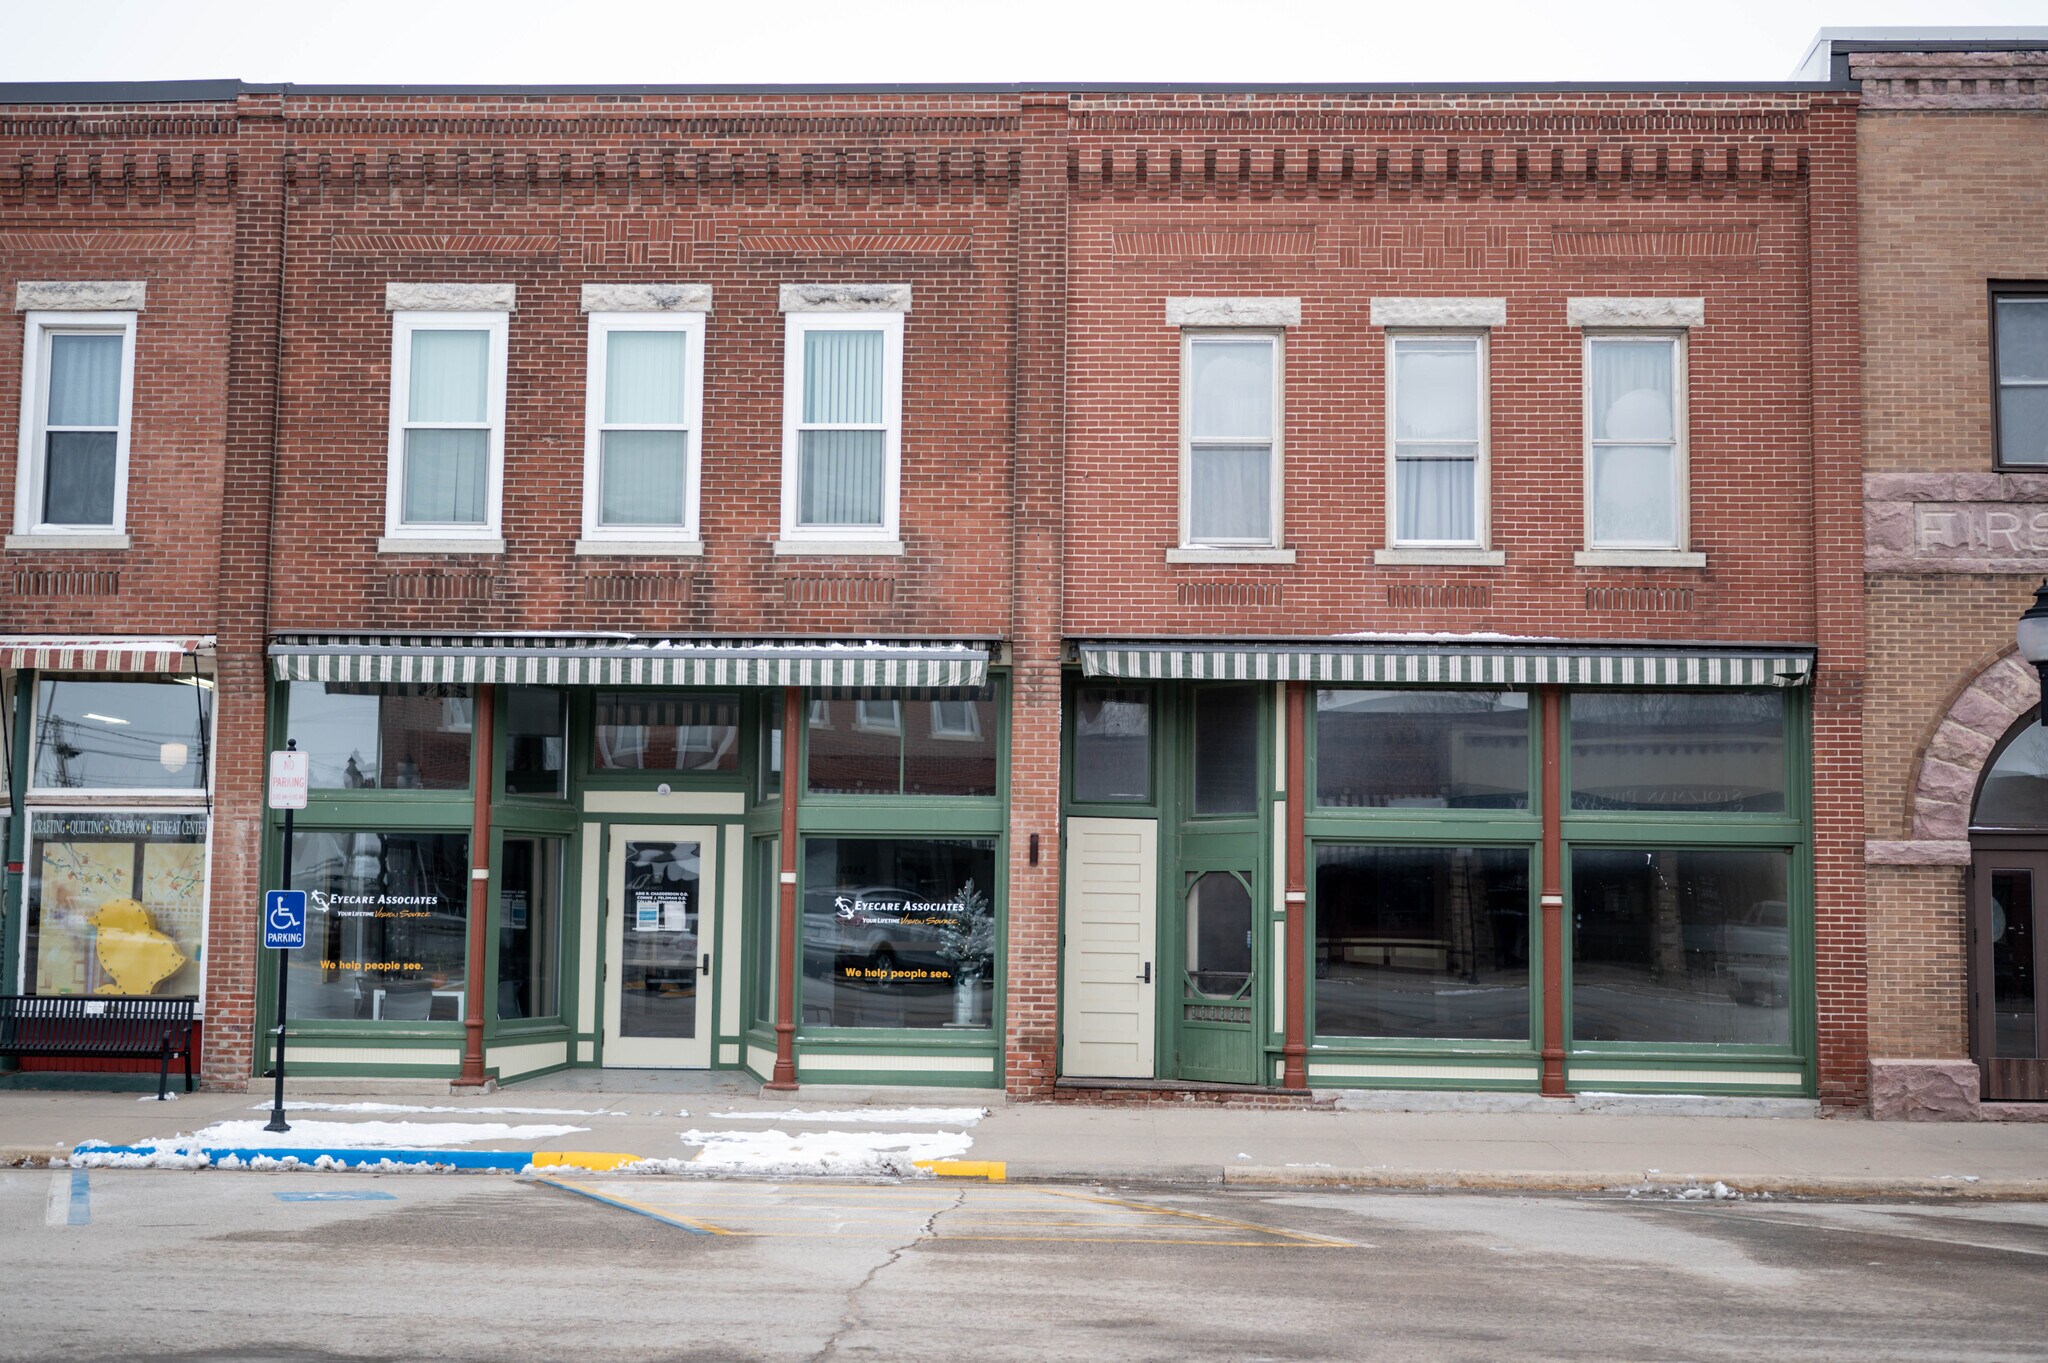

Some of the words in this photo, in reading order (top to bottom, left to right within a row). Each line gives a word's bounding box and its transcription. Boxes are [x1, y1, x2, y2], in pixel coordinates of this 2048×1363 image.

[283, 759, 295, 770] NO
[273, 777, 305, 788] PARKING
[33, 820, 66, 834] CRAFTING
[69, 820, 104, 835] QUILTING
[109, 820, 147, 835] SCRAPBOOK
[152, 820, 180, 835] RETREAT
[181, 821, 207, 835] CENTER
[330, 894, 376, 905] EYECARE
[377, 894, 438, 905] ASSOCIATES
[854, 900, 901, 911] EYECARE
[902, 900, 965, 912] ASSOCIATES
[267, 932, 302, 944] PARKING
[320, 960, 336, 970] We
[339, 960, 362, 972] help
[364, 960, 401, 972] people
[403, 962, 424, 970] see.
[845, 967, 862, 977] We
[864, 968, 888, 979] help
[890, 968, 927, 980] people
[930, 970, 952, 978] see.
